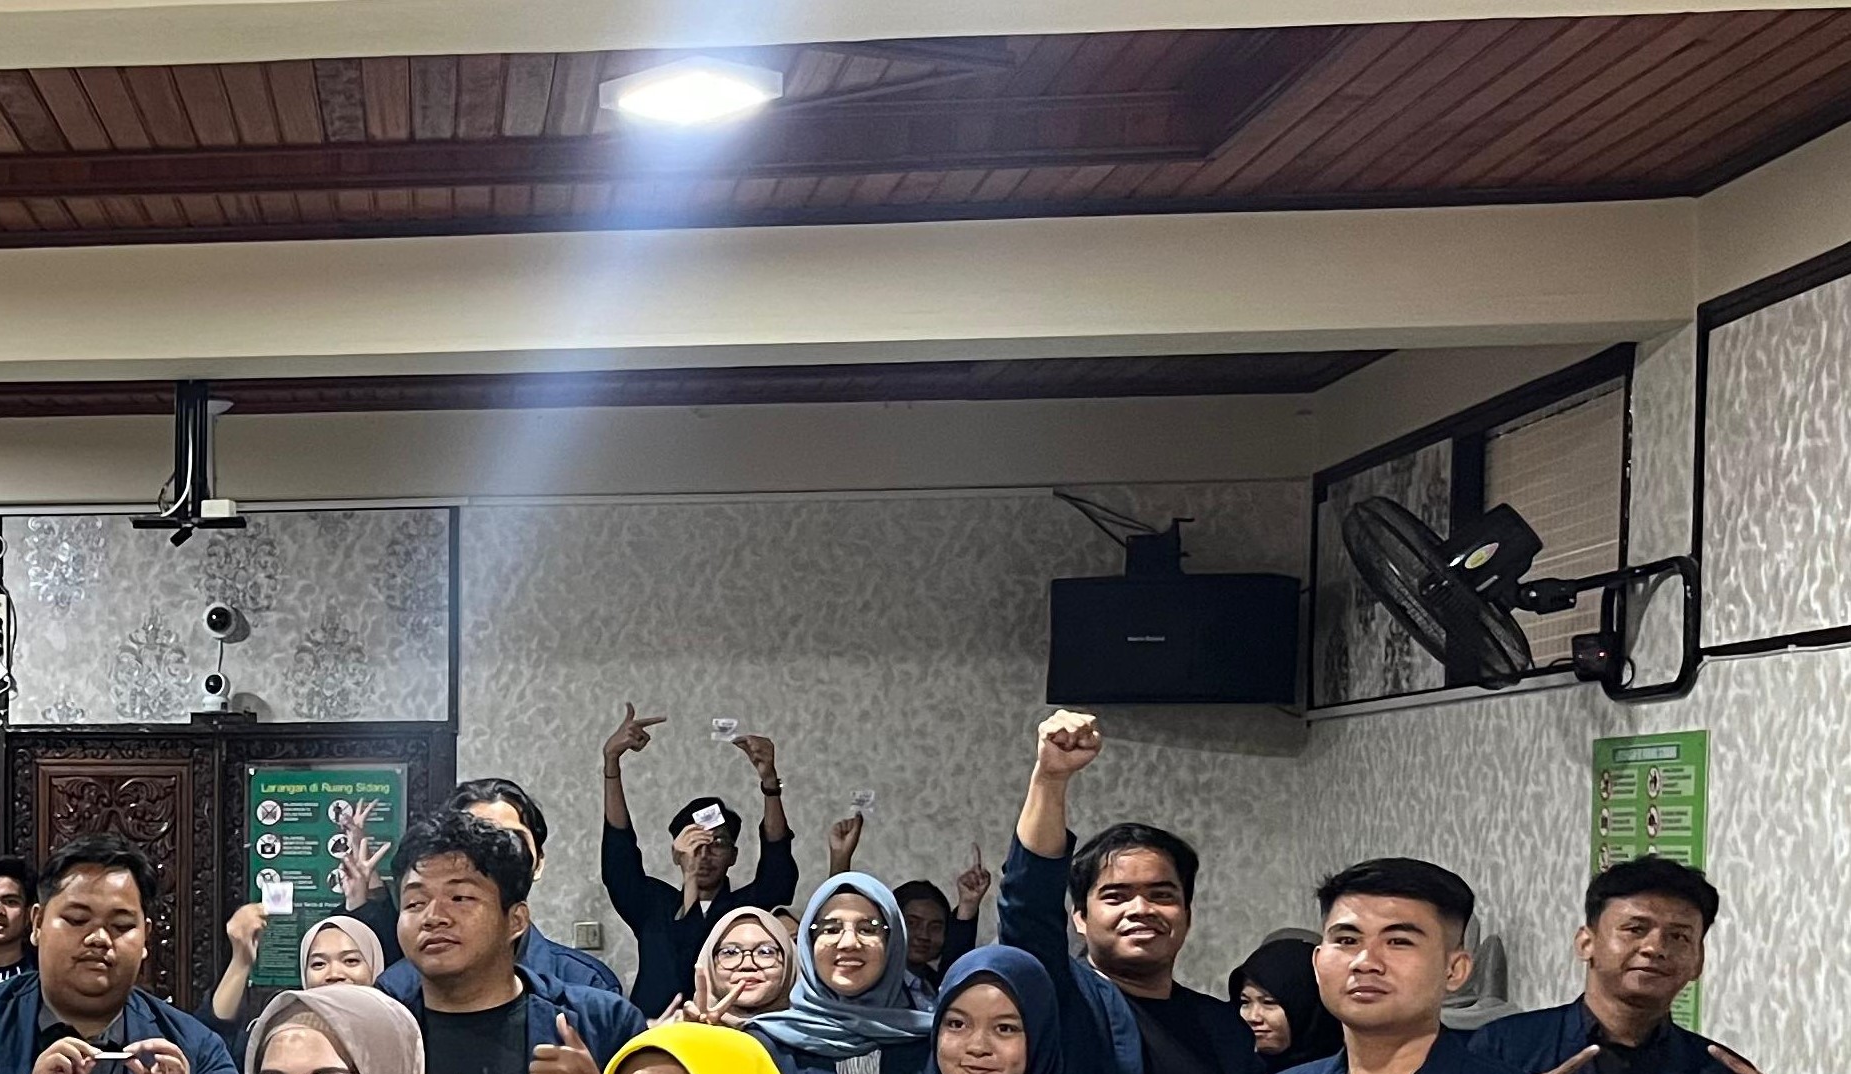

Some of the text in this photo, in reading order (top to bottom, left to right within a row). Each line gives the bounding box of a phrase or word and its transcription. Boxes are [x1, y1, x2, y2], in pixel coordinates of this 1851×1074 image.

[260, 782, 390, 795] Larangan di Ruang Sidang
